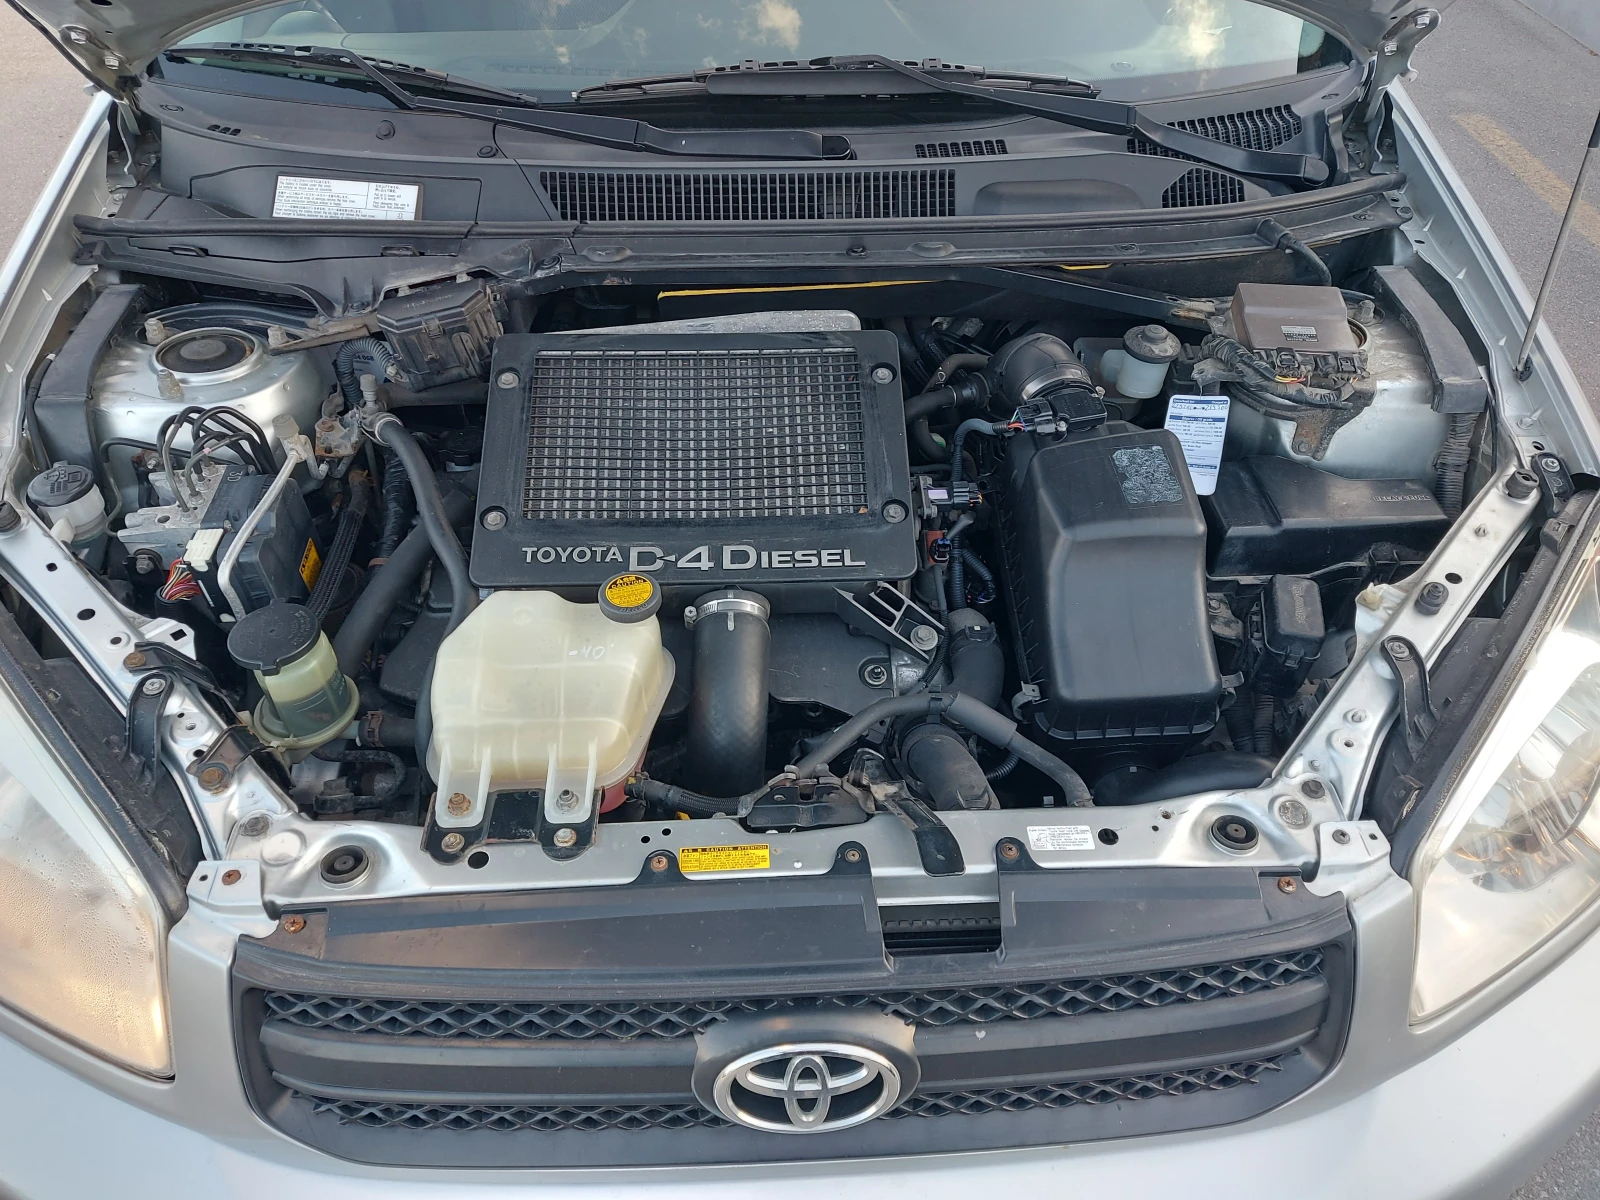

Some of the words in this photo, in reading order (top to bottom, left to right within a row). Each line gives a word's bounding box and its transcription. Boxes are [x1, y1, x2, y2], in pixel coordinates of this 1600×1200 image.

[522, 546, 624, 564] TOYOTA
[628, 545, 715, 572] D-4
[722, 545, 866, 568] DIESEL
